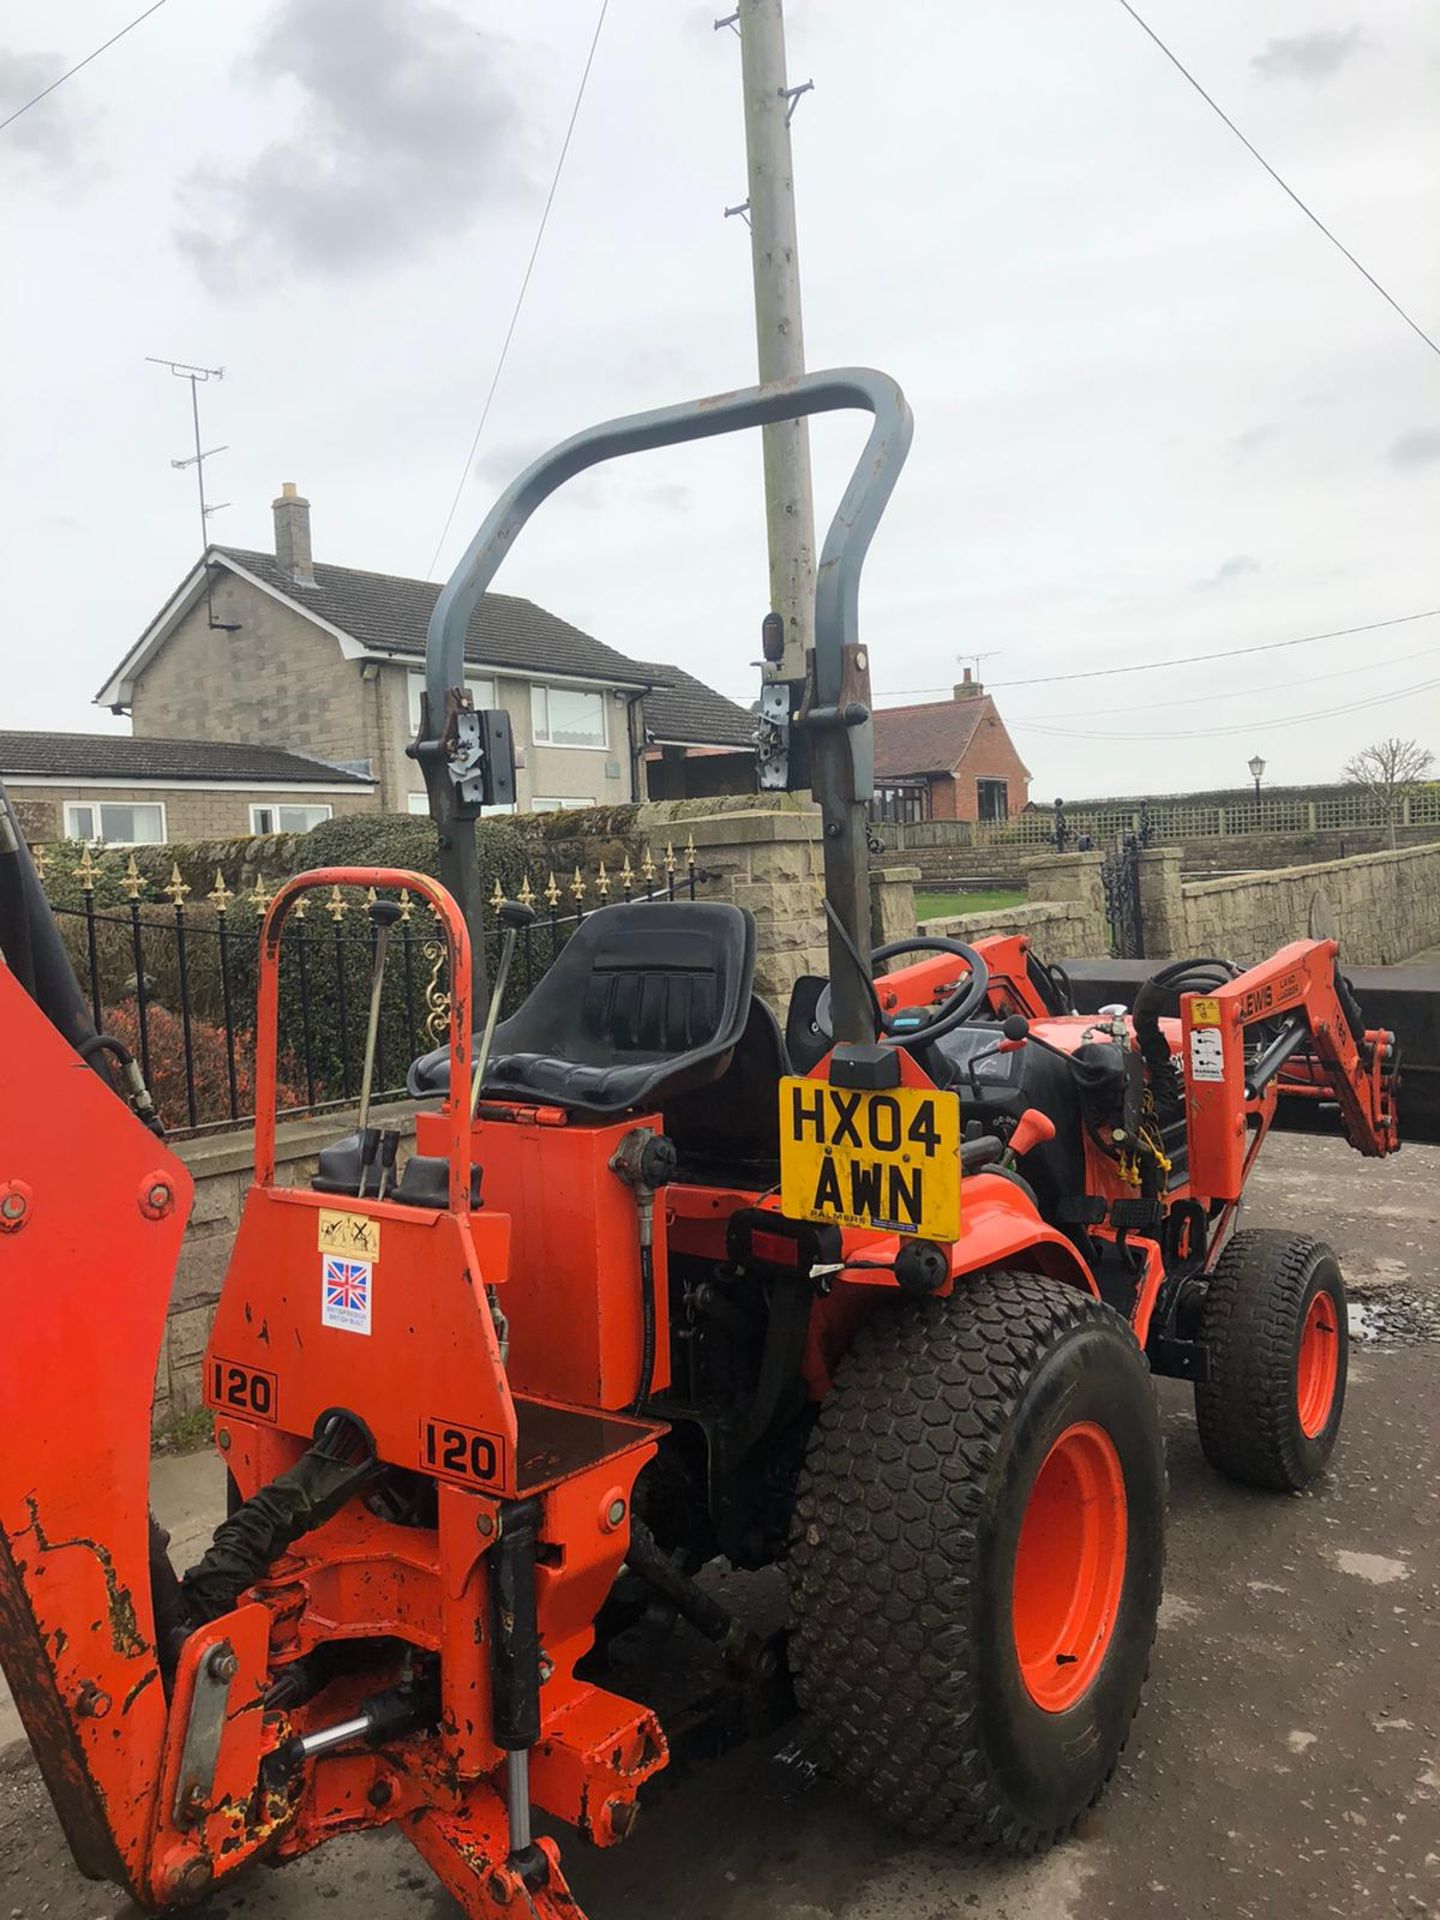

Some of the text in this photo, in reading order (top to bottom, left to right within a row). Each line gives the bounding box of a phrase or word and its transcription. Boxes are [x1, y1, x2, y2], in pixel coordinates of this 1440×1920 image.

[1240, 985, 1272, 1017] LEWIS
[793, 1087, 941, 1157] HX04
[814, 1156, 922, 1225] AWN
[809, 1210, 866, 1225] PALMERS
[215, 1363, 270, 1414] 120
[427, 1424, 496, 1480] 120
